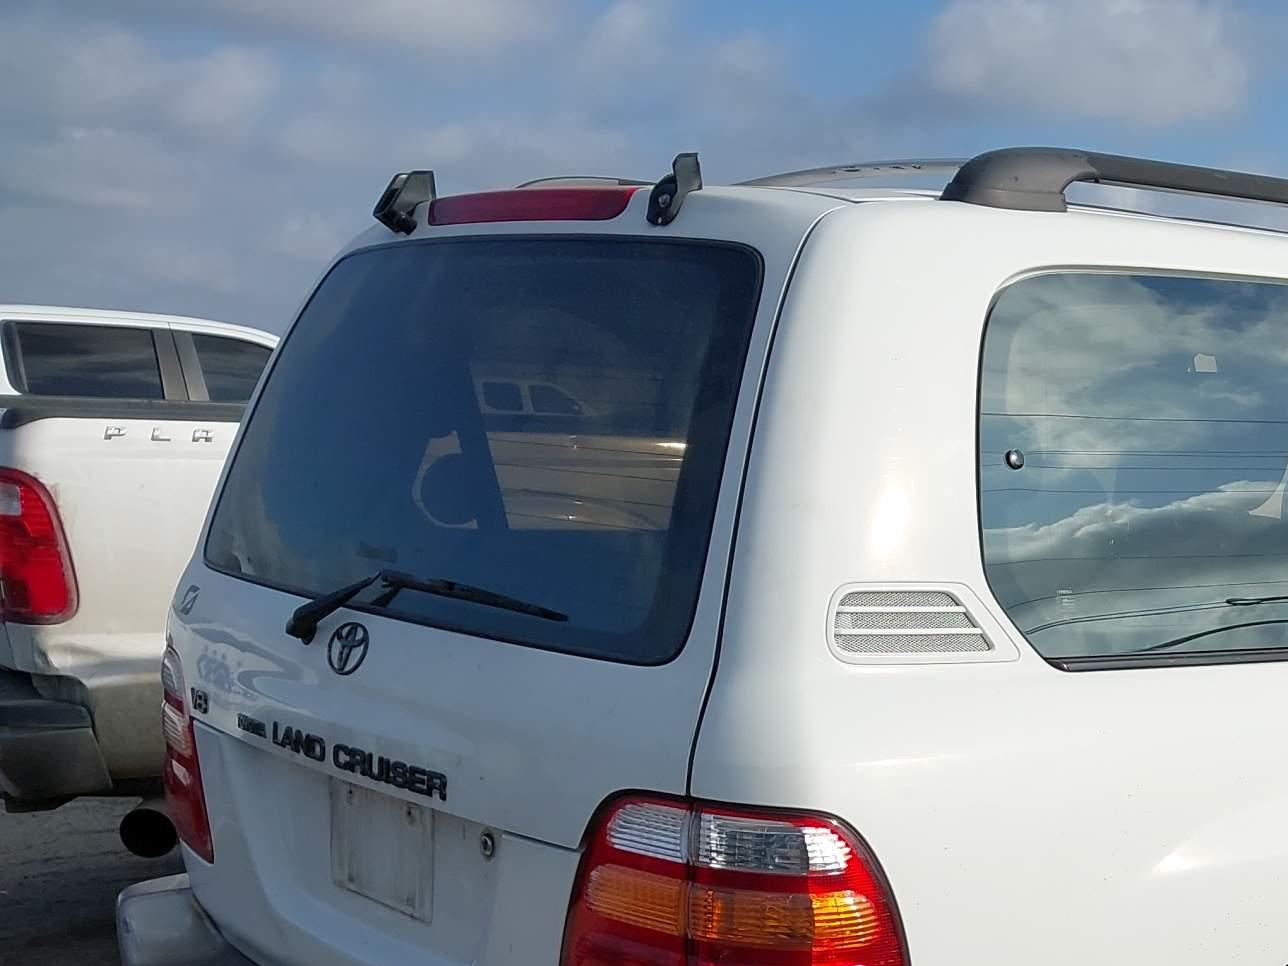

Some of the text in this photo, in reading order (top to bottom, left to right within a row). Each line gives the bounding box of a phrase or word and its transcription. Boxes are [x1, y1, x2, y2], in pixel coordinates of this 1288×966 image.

[190, 687, 209, 714] V8
[272, 721, 326, 762] LAND
[332, 743, 448, 802] CRUISER
